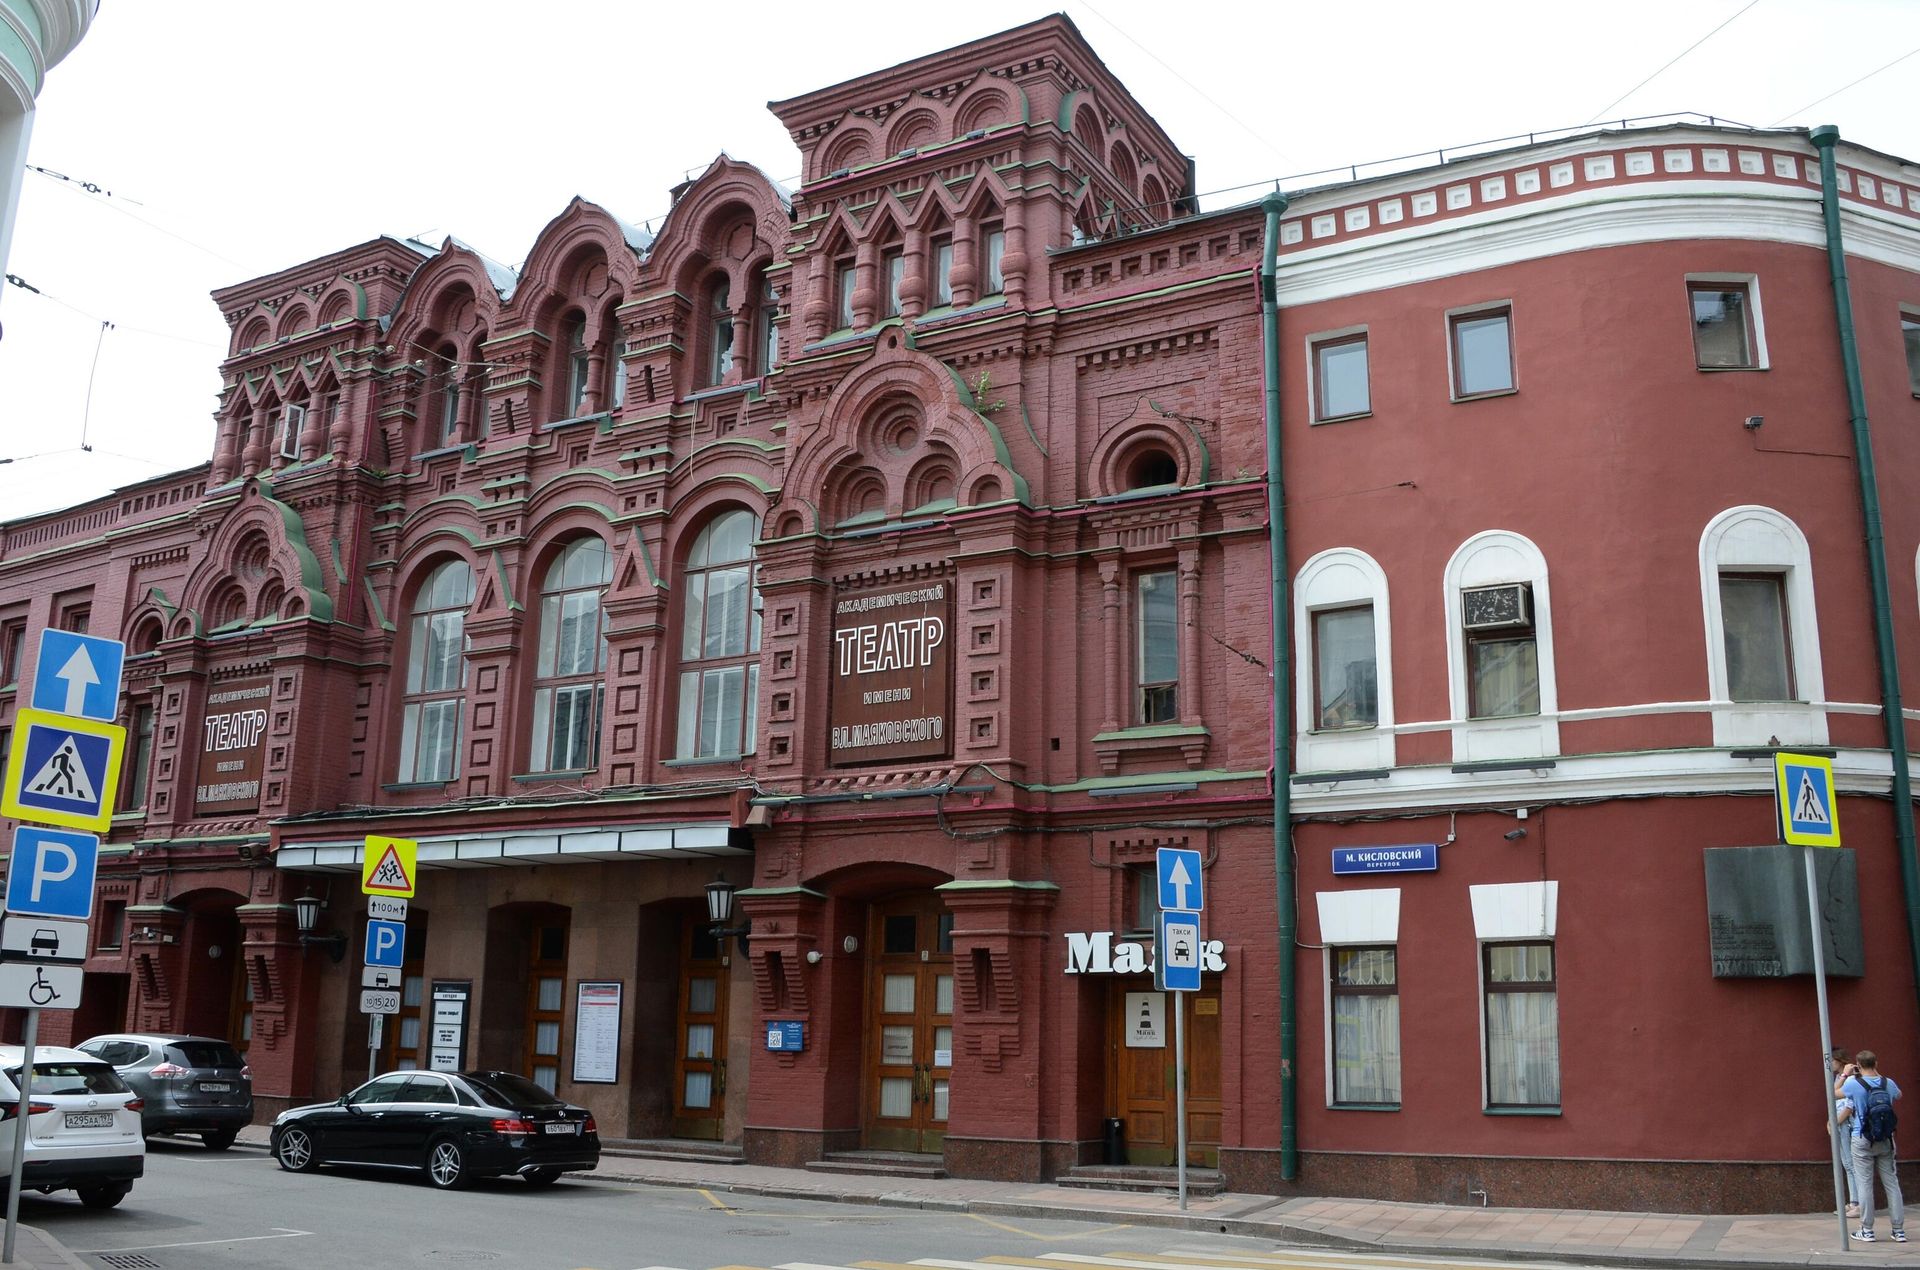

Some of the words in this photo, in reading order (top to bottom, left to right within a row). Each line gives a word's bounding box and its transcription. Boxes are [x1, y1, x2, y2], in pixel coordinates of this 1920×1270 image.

[837, 584, 944, 613] АКАДЕМИЧЕСКИЙ
[836, 616, 944, 676] ТЕАТР
[863, 688, 911, 704] ИМЕНИ
[205, 709, 268, 752] ТЕАТР
[30, 841, 77, 902] P
[1358, 849, 1422, 862] КИСЛОВСКИЙ
[375, 926, 397, 960] P
[1064, 931, 1228, 974] Мак
[374, 996, 382, 1006] 15
[384, 997, 396, 1008] 20
